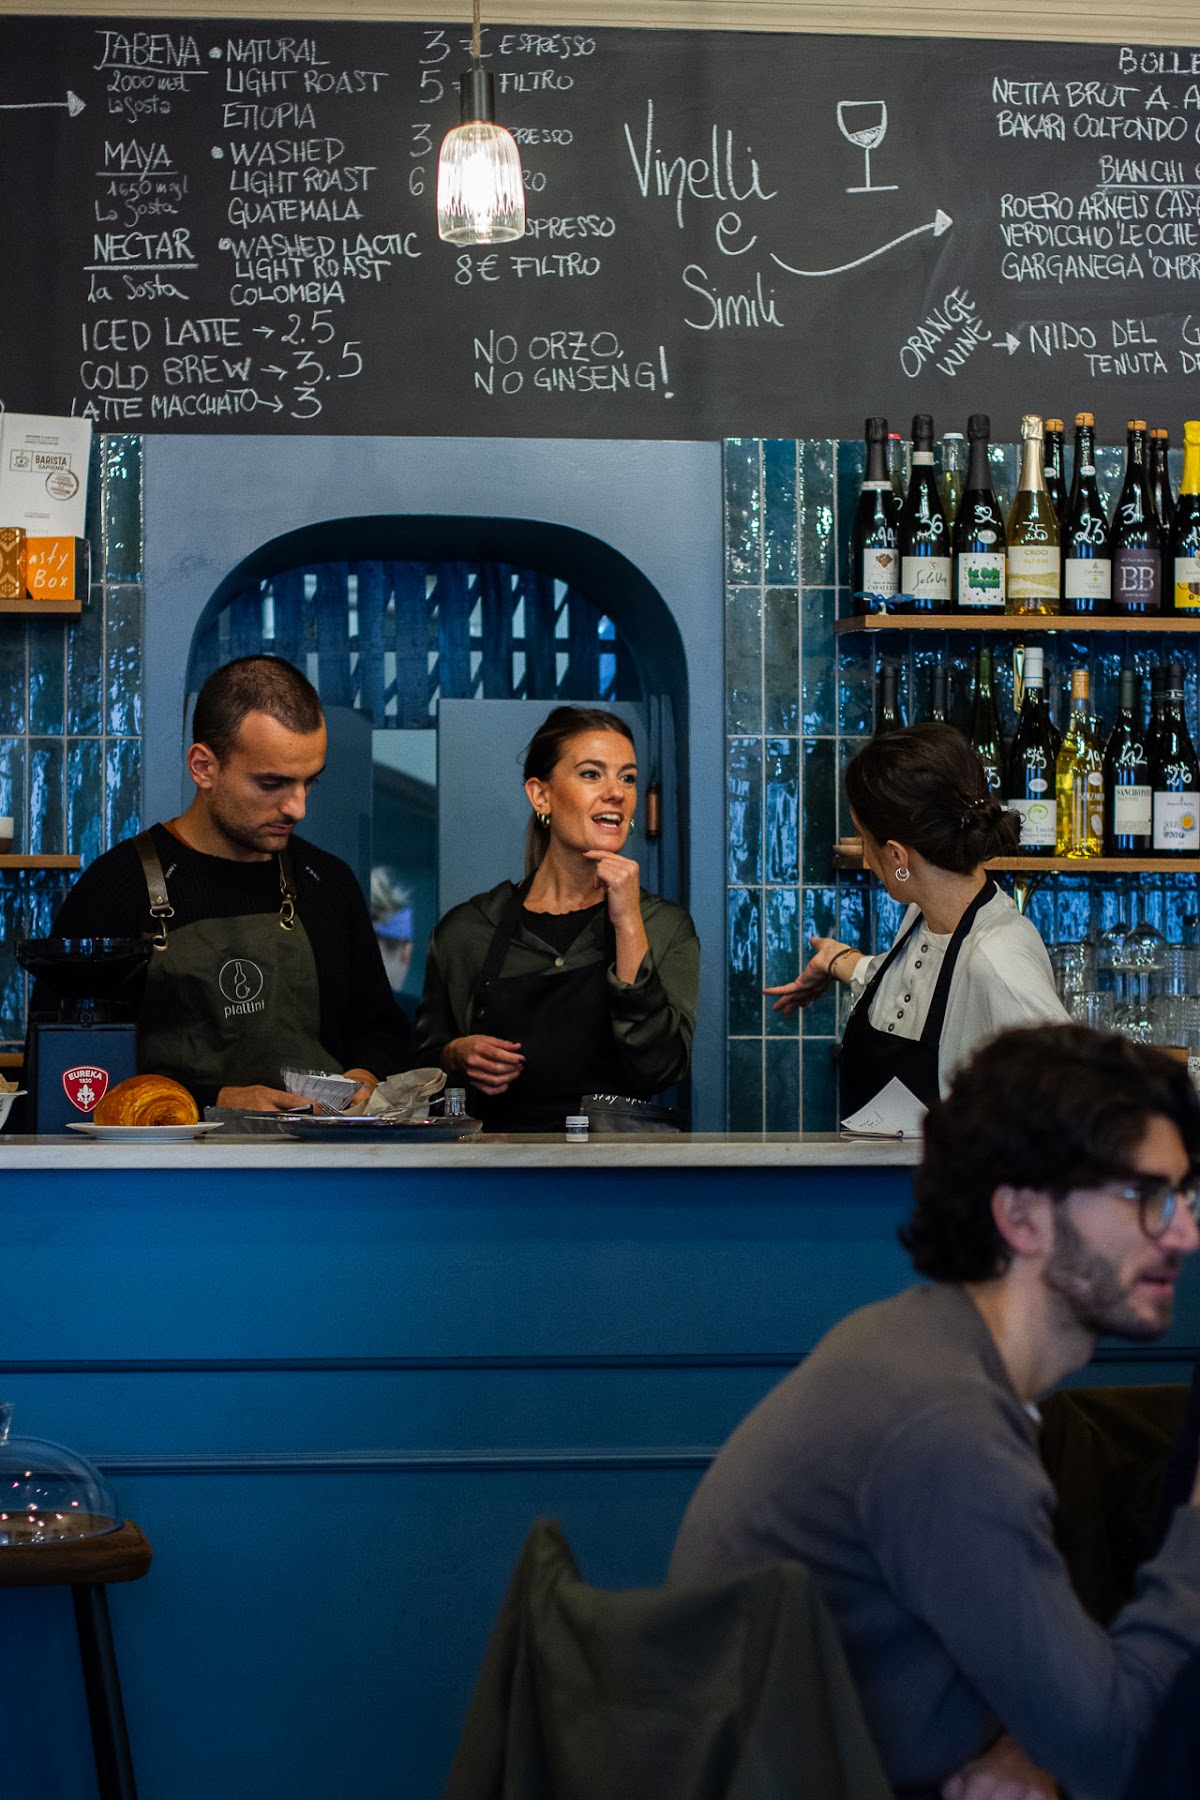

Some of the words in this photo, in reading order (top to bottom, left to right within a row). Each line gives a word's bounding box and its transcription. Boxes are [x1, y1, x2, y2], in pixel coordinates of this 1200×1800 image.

[227, 37, 331, 65] NATURAL
[498, 33, 597, 60] ESPRESSO
[107, 70, 155, 92] 2000
[227, 68, 298, 97] LIGHT
[303, 69, 389, 94] ROAST
[499, 69, 574, 93] FILTRO
[992, 76, 1060, 106] NETTA
[1065, 81, 1141, 107] BRUT
[222, 101, 317, 130] ETIOPIA
[996, 110, 1066, 142] BAKARI
[508, 127, 574, 146] PRESSO
[104, 138, 174, 182] MAYA
[229, 137, 346, 166] WASHED
[229, 169, 299, 198] LIGHT
[303, 166, 378, 193] ROAST
[1099, 154, 1184, 184] BIANCHI
[227, 197, 364, 229] GUATEMALA
[1000, 191, 1074, 220] ROERO
[1078, 190, 1149, 222] ARNEIS
[522, 215, 616, 240] SPRESSO
[1000, 223, 1113, 249] VERDICCHIO
[93, 228, 196, 262] NECTAR
[230, 234, 335, 260] WASHED
[234, 258, 305, 283] LIGHT
[314, 257, 391, 281] ROAST
[510, 252, 601, 278] FILTRO
[1001, 252, 1144, 284] GARGANEGA
[229, 281, 346, 306] COLOMBIA
[682, 264, 785, 330] Simili
[82, 319, 150, 351] ICED
[165, 317, 242, 346] LATTE
[281, 309, 336, 345] 2.5
[900, 286, 976, 378] ORANGE
[1029, 321, 1097, 357] NIDO
[1112, 318, 1158, 348] DEL
[474, 329, 518, 364] NO
[528, 330, 626, 362] ORZO,
[936, 316, 992, 377] WINE
[80, 360, 149, 391] COLD
[163, 354, 252, 386] BREW
[292, 341, 363, 387] 3.5
[1084, 350, 1168, 377] TENUTA
[474, 365, 524, 395] NO
[291, 386, 323, 420] 3
[35, 454, 68, 467] BARISTA
[914, 513, 944, 537] 36
[29, 542, 69, 572] asty
[33, 569, 68, 588] Box
[1120, 566, 1155, 592] BB
[224, 1000, 265, 1019] piattini
[68, 1070, 103, 1081] EUREKA
